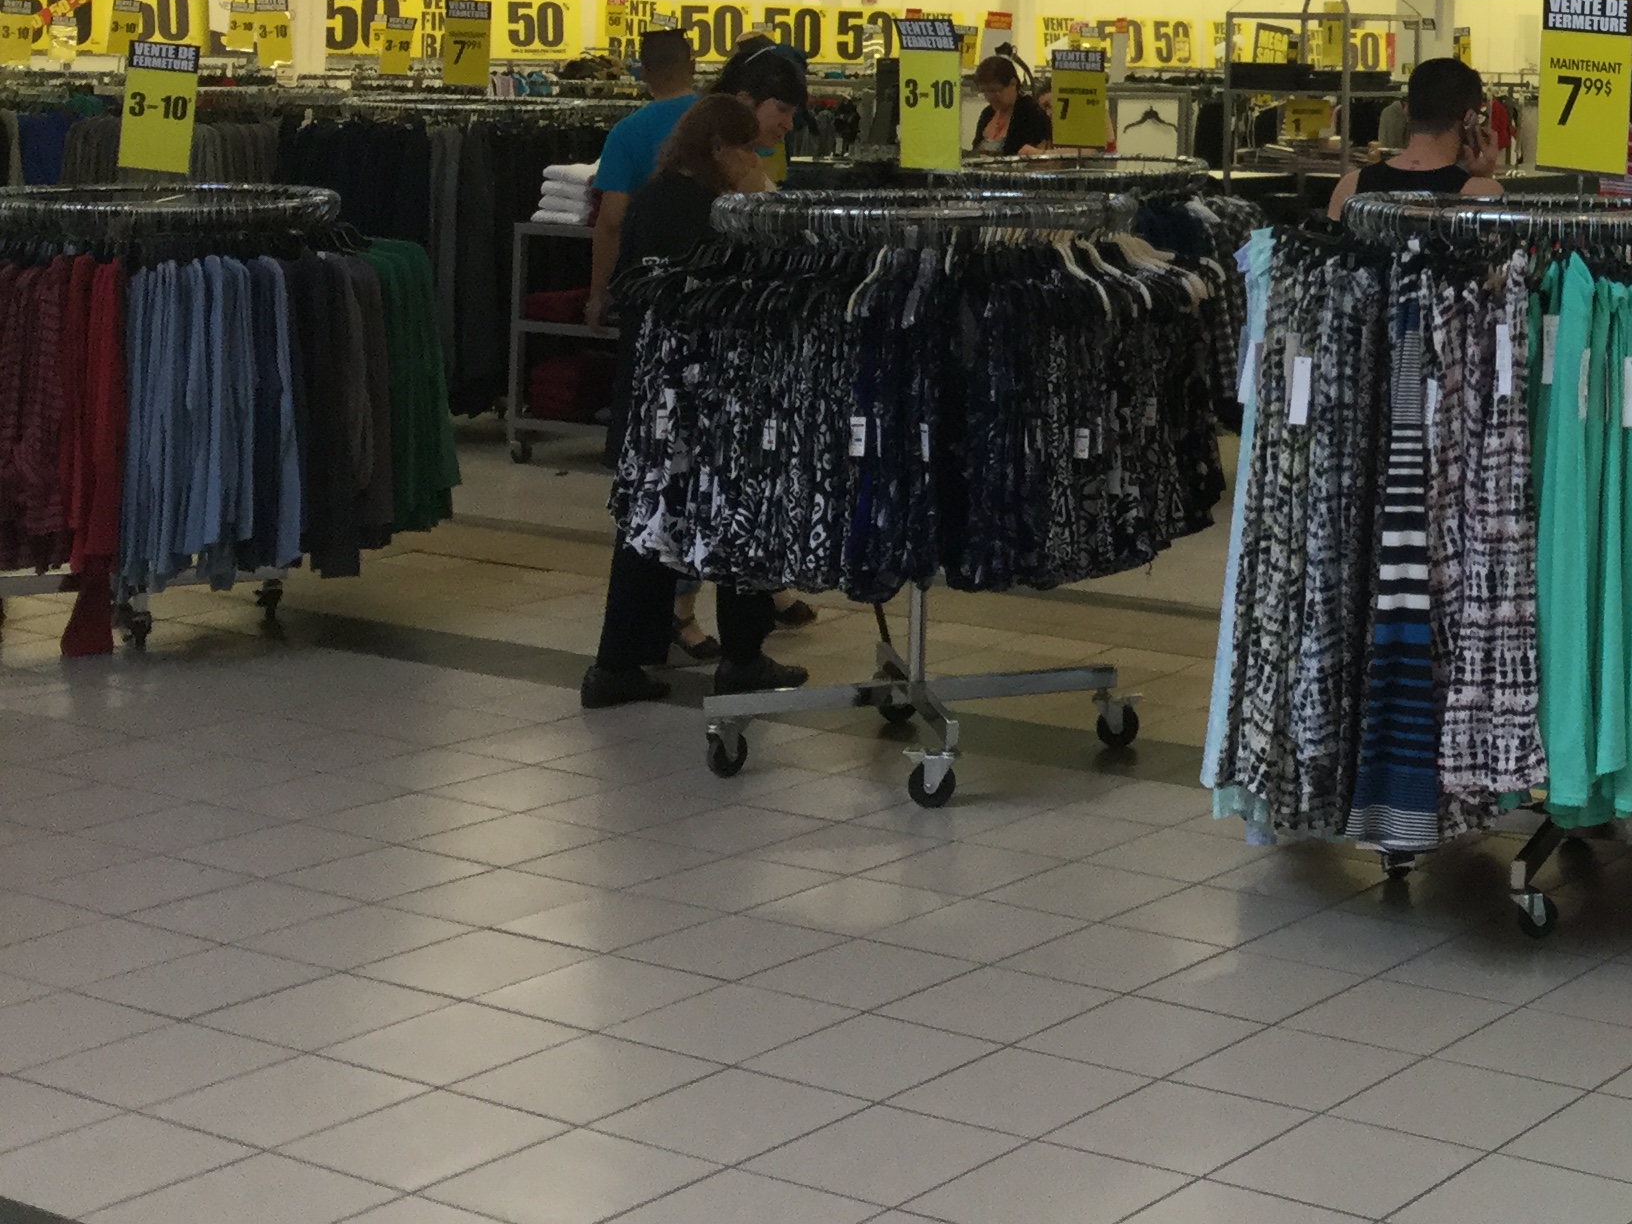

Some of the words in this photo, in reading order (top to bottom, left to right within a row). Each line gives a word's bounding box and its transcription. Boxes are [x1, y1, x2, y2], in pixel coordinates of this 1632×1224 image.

[1605, 0, 1628, 17] DE
[900, 21, 936, 35] VENTE
[938, 22, 950, 35] DE
[1548, 13, 1627, 33] FERMETURE
[134, 42, 176, 59] VENTE
[178, 46, 196, 60] DE
[902, 36, 955, 49] FERMETURE
[133, 55, 195, 72] FERMETURE
[1550, 57, 1622, 74] MAINTENANT
